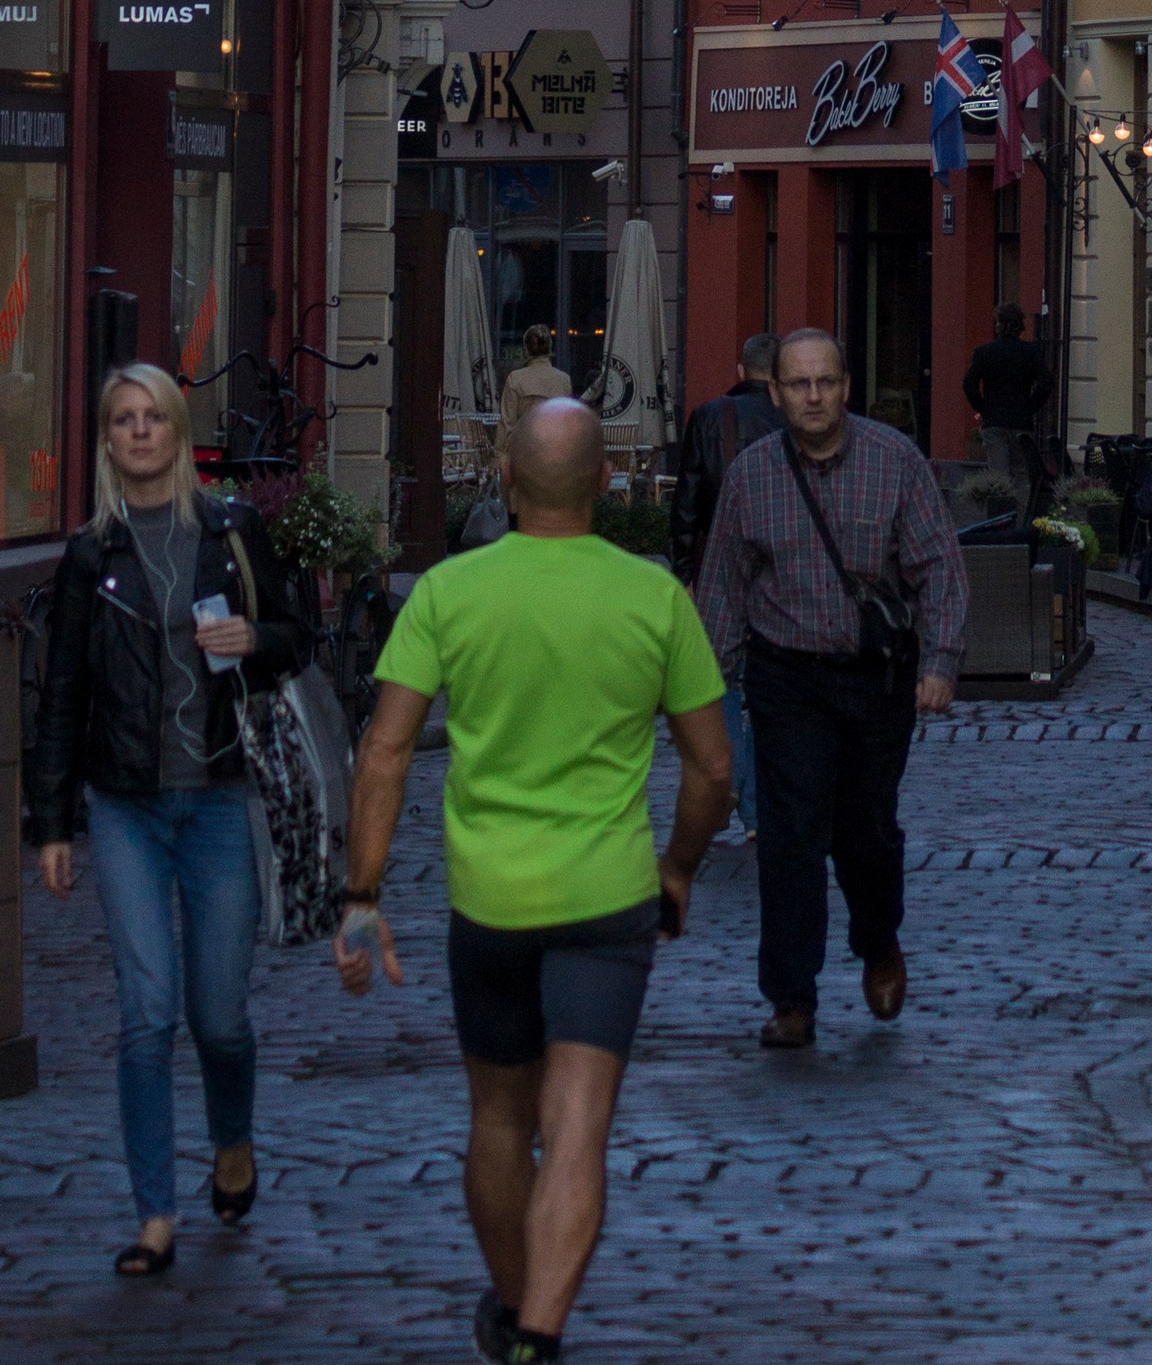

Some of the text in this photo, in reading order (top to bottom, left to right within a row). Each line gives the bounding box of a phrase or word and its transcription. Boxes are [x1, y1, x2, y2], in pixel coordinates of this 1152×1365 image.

[118, 5, 194, 23] LUMAS
[541, 96, 585, 114] BITE
[709, 85, 798, 113] KONDITOREJA
